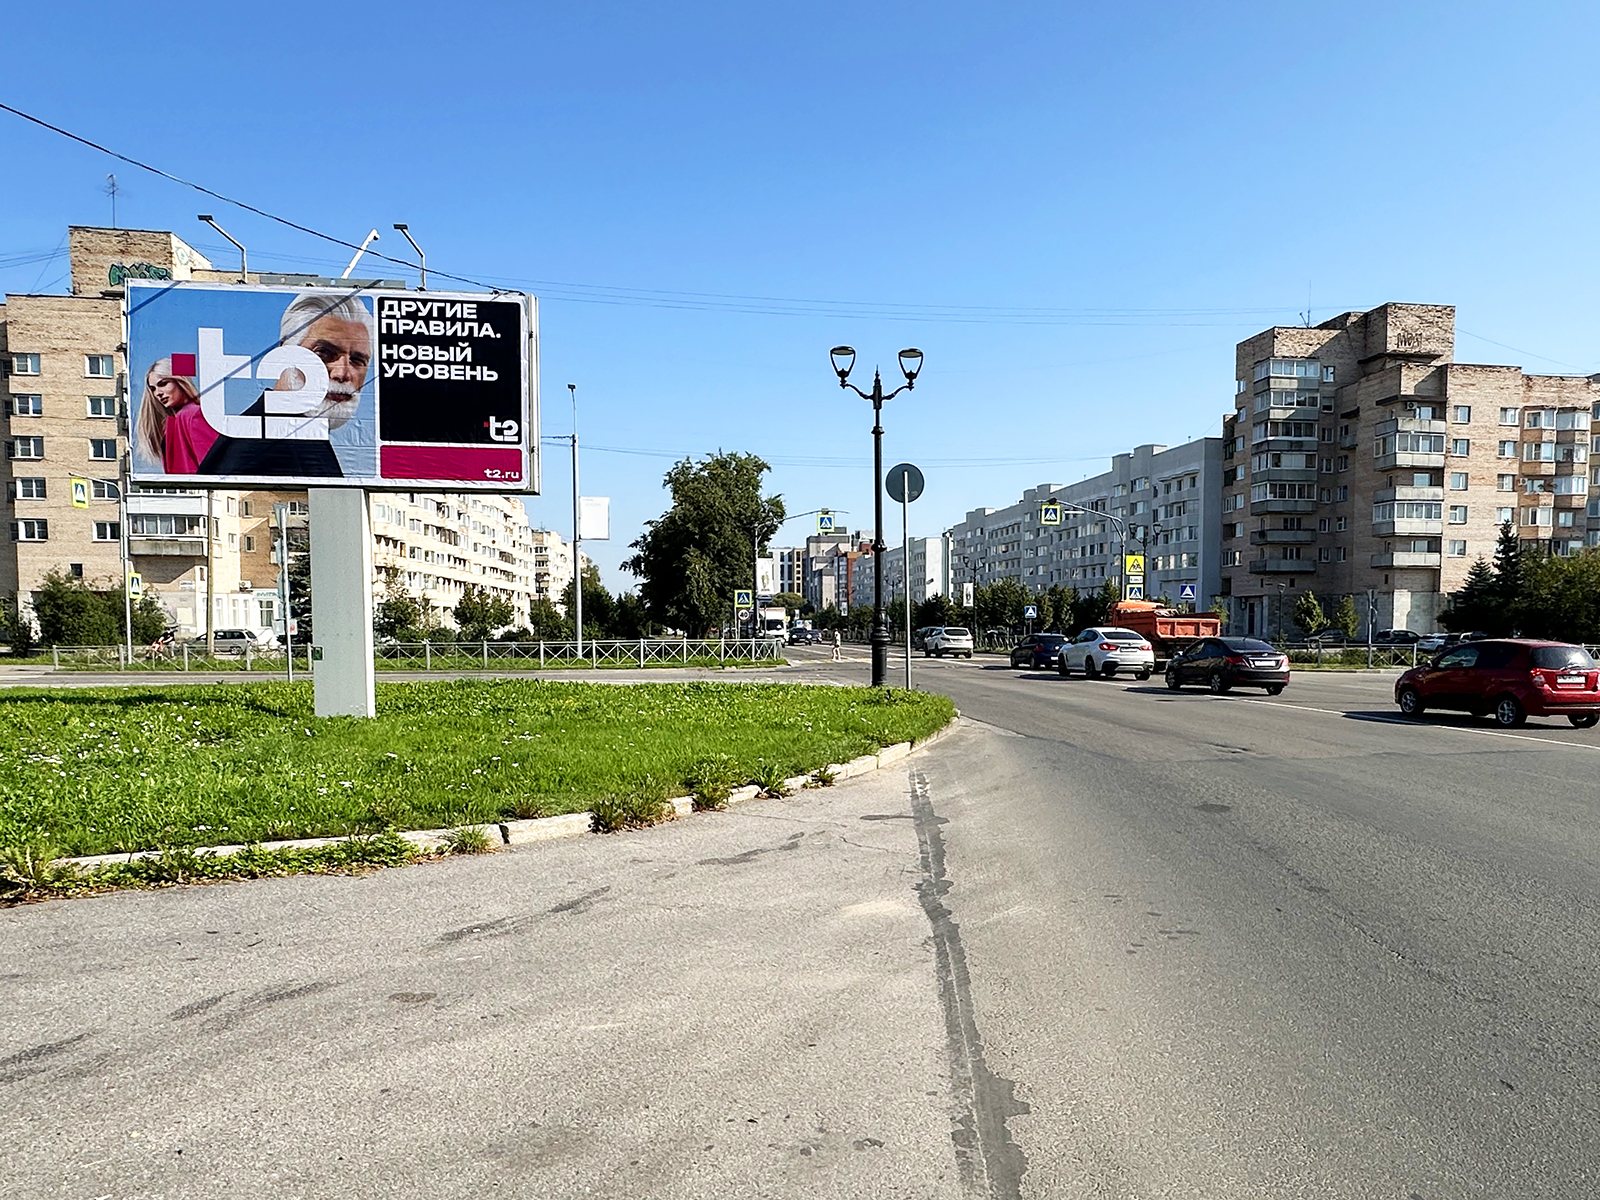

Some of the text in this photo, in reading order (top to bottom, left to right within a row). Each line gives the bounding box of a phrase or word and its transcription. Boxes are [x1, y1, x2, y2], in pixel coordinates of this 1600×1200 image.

[381, 300, 478, 319] ДРУГИЕ
[381, 318, 501, 338] ПРАВИЛА.
[381, 342, 472, 362] НОВЫЙ
[381, 362, 498, 381] УРОВЕНЬ
[198, 327, 330, 440] t2
[489, 416, 519, 442] t2
[483, 468, 520, 479] t2.ru
